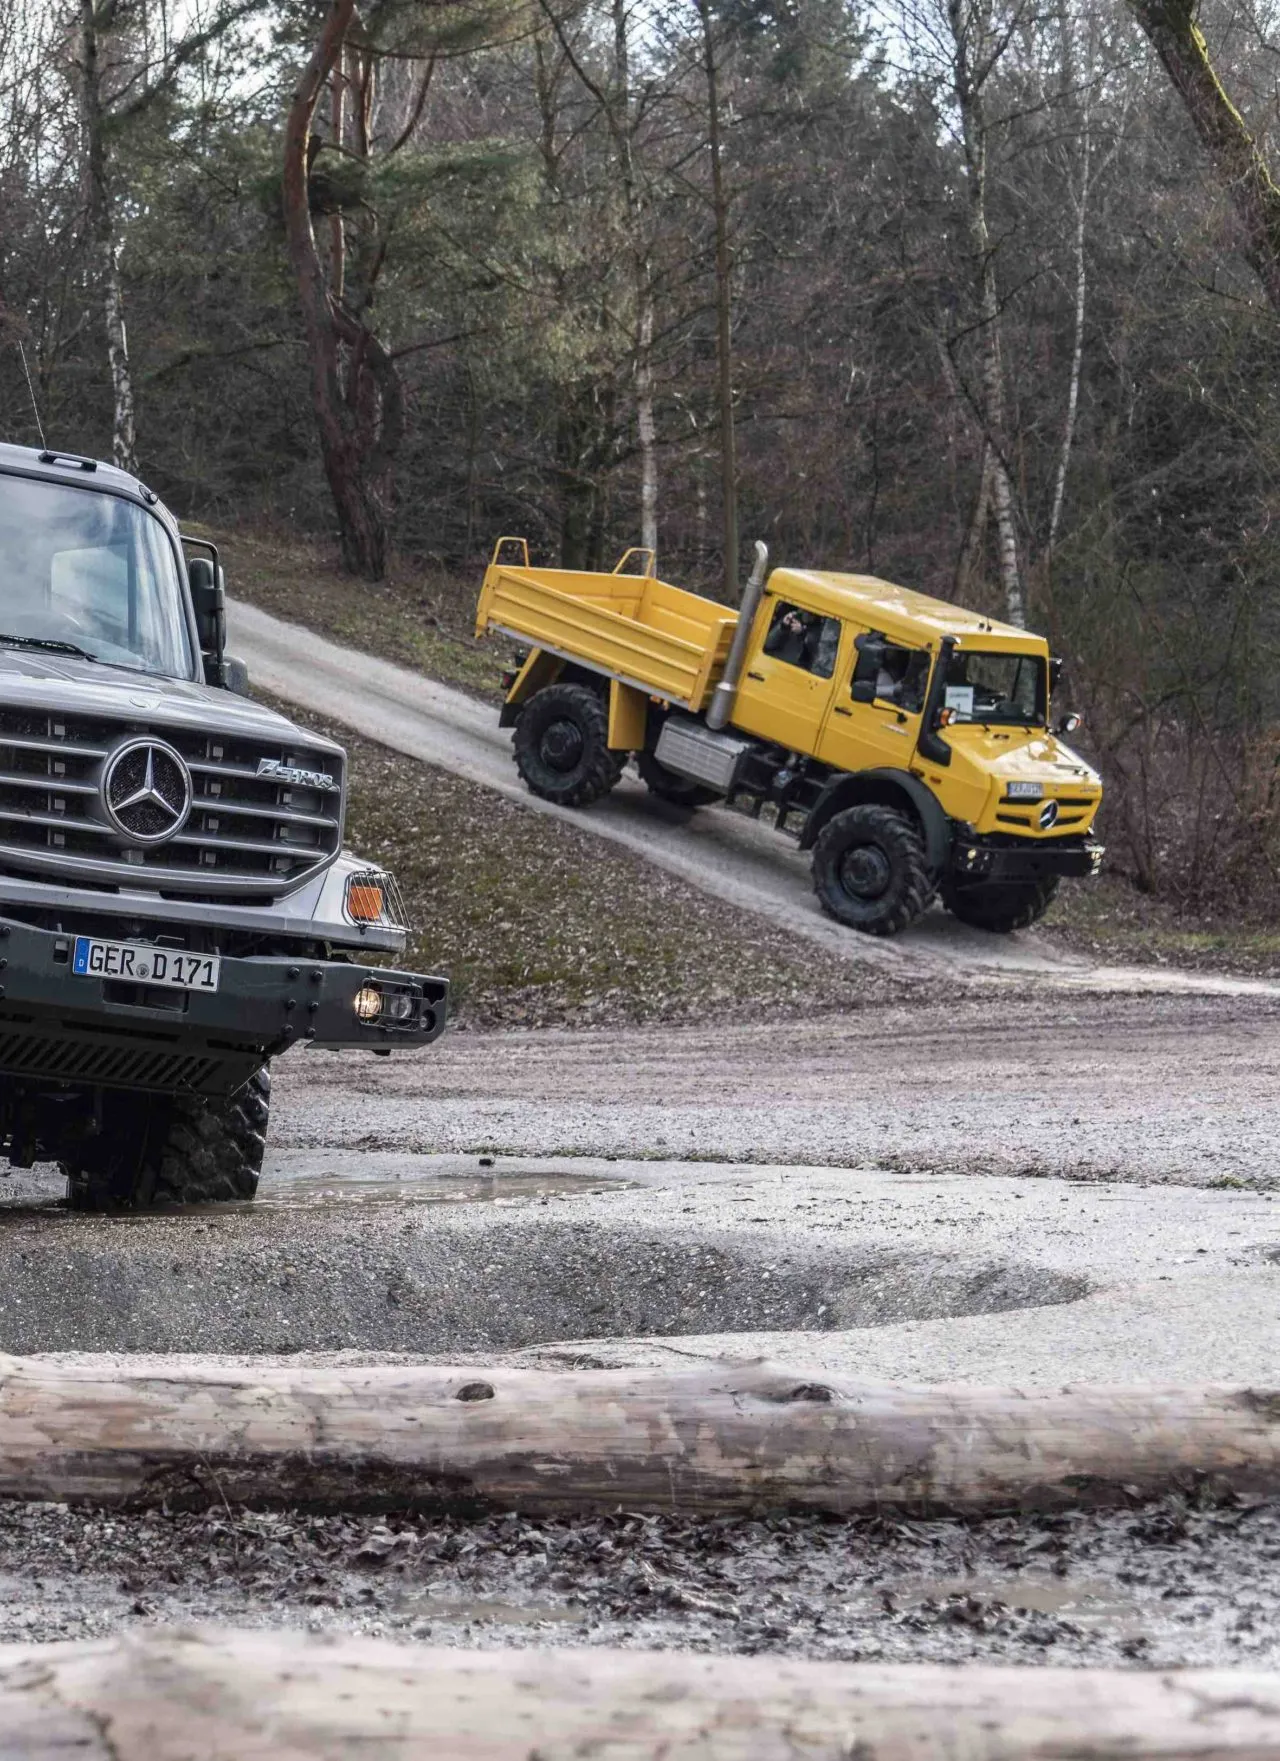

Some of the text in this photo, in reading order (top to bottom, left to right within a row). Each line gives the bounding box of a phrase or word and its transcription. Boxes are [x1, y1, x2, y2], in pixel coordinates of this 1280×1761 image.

[256, 758, 333, 788] ZETROS
[89, 944, 215, 987] GER D 171
